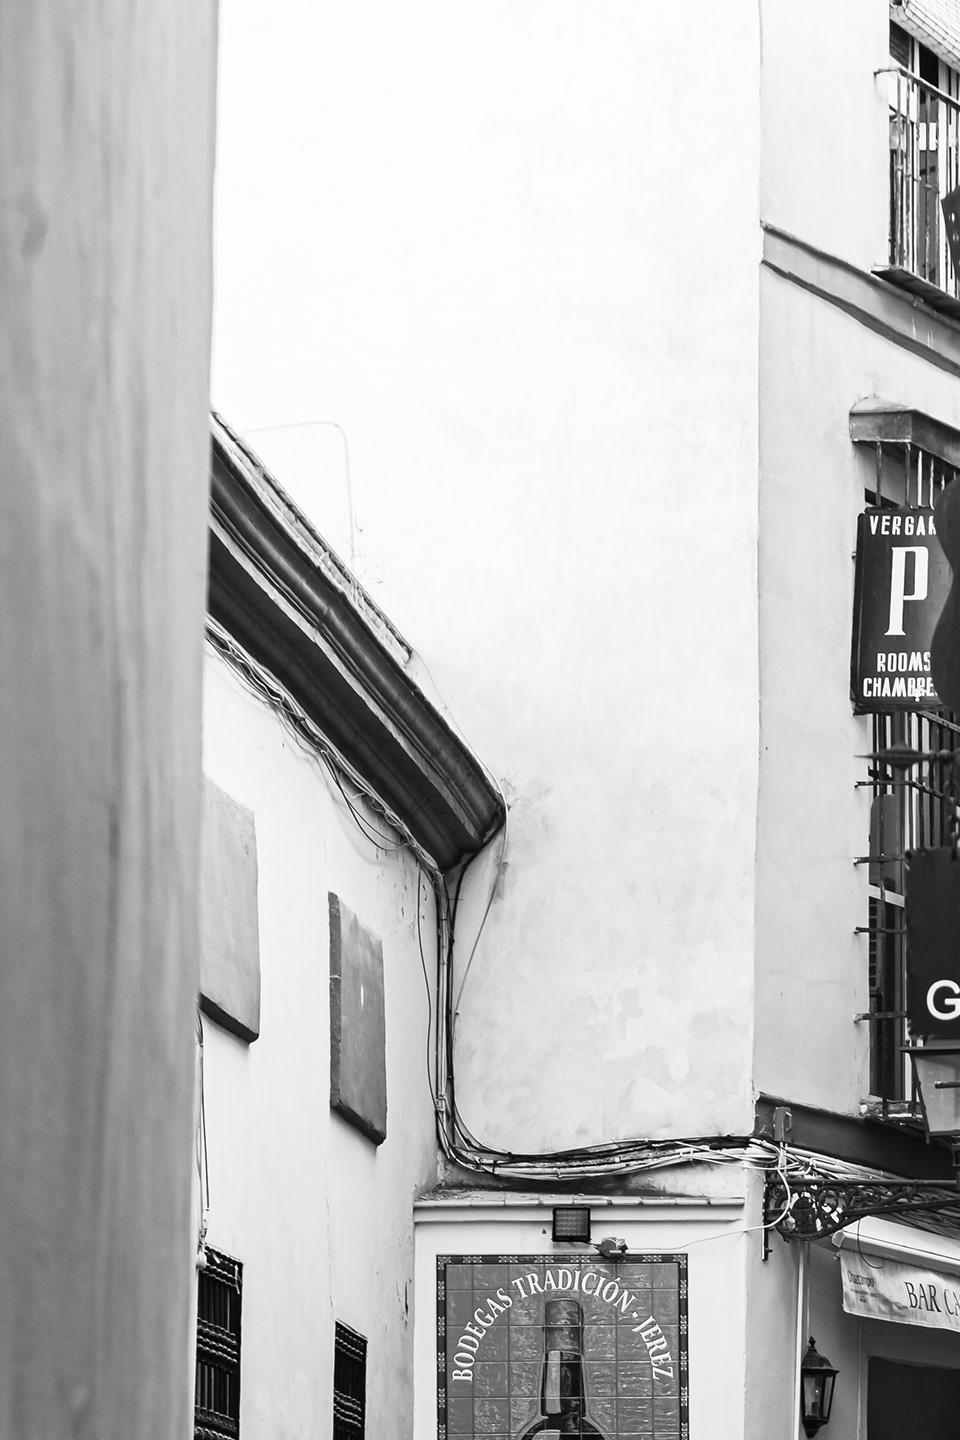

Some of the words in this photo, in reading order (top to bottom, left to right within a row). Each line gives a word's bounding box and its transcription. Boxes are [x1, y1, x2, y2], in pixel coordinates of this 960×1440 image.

[869, 515, 937, 536] VERGAR
[884, 546, 929, 636] P
[876, 651, 931, 673] ROOMS
[863, 676, 939, 698] CHAMBRE
[903, 1281, 943, 1313] BAR
[451, 1287, 514, 1383] BODEGAS
[511, 1268, 637, 1314] TRADICIÓN
[631, 1315, 675, 1381] JEREZ
